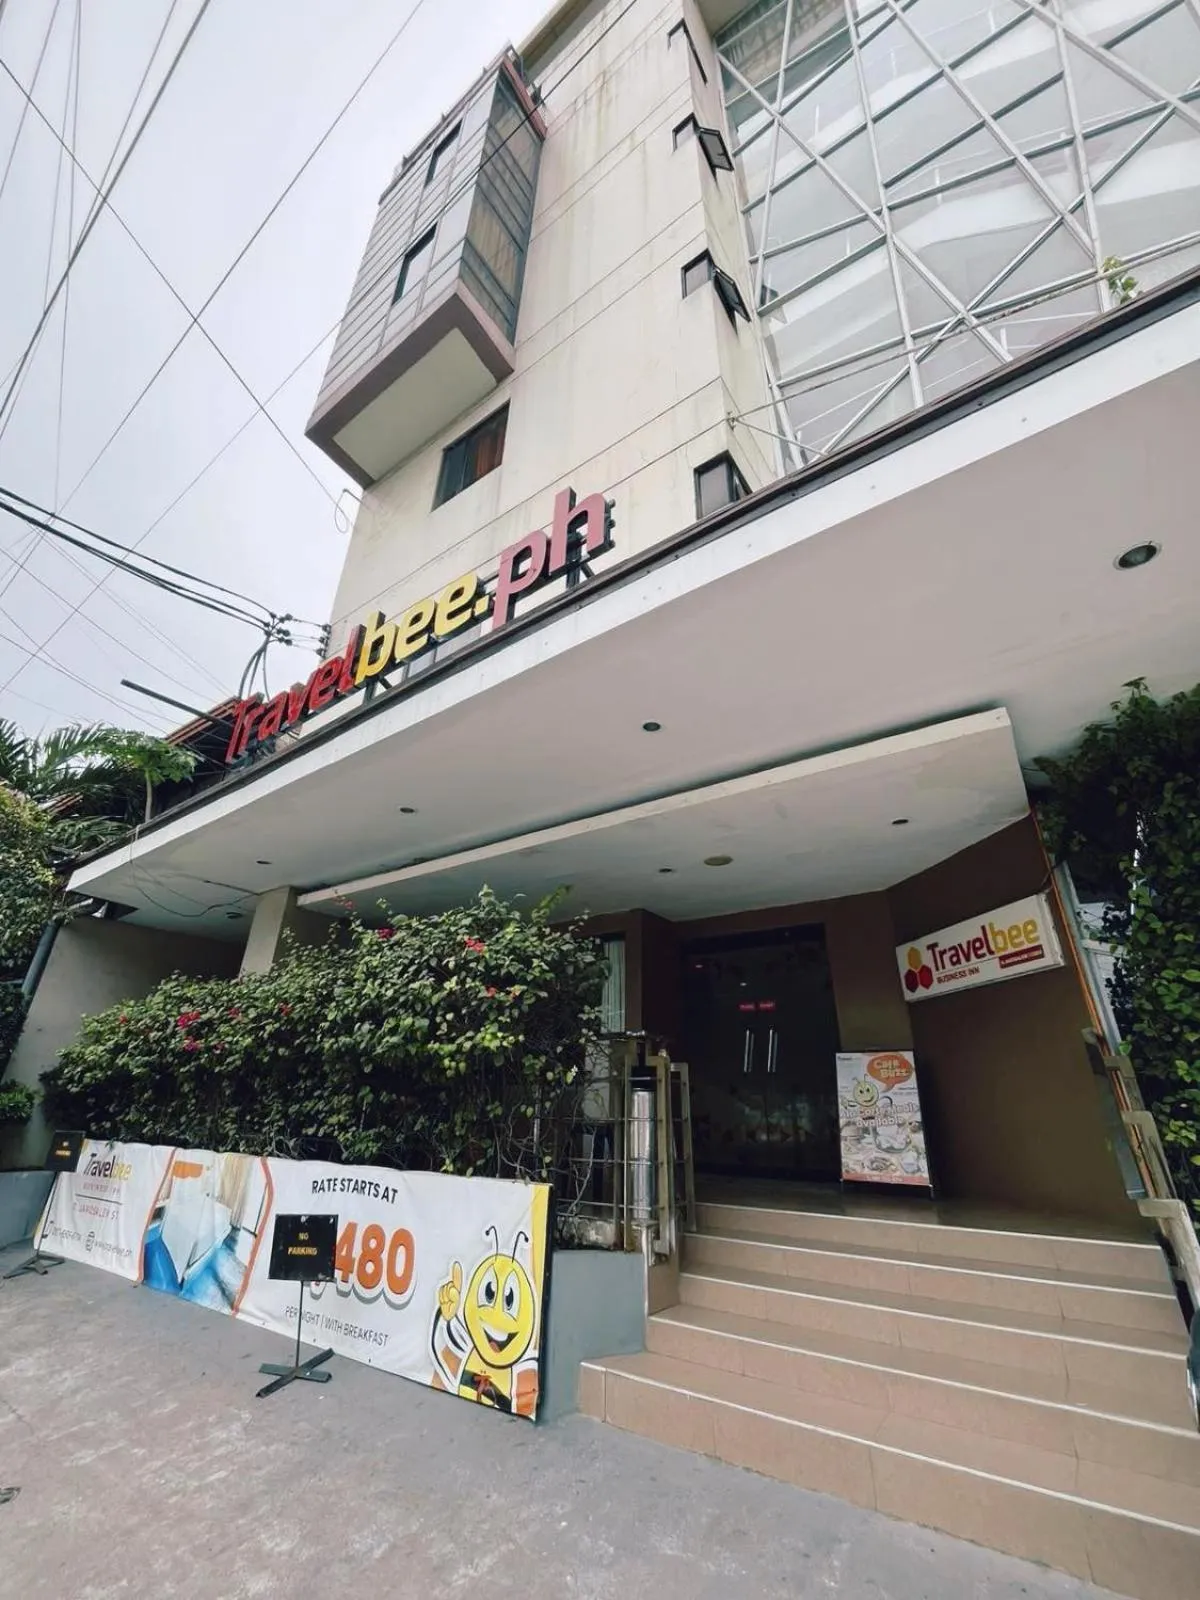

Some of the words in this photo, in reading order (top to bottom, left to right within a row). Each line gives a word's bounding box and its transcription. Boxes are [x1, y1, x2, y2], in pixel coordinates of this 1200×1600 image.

[223, 486, 614, 766] Travelbee.ph
[926, 919, 1040, 972] Travelbee
[936, 971, 967, 984] BUSINESS
[969, 966, 980, 977] INN
[312, 1178, 338, 1194] RATE
[340, 1178, 380, 1199] STARTS
[381, 1186, 398, 1204] AT
[298, 1232, 309, 1241] NO
[287, 1246, 318, 1256] PARKING
[335, 1221, 416, 1295] 480
[325, 1315, 342, 1334] WITH
[343, 1323, 389, 1346] BREAKFAST
